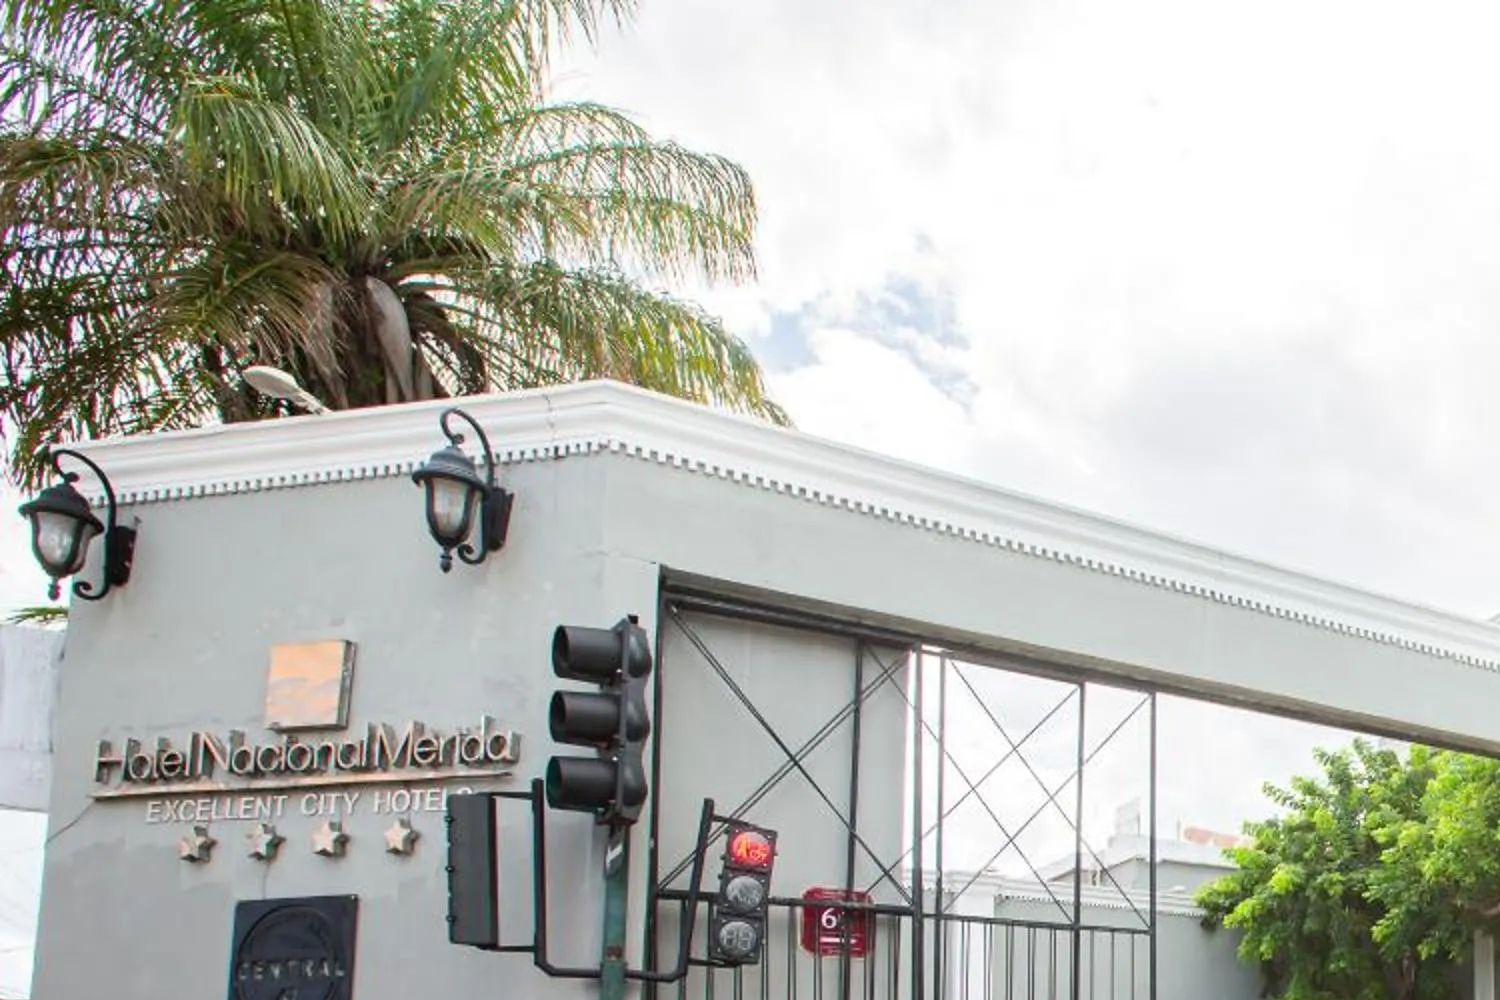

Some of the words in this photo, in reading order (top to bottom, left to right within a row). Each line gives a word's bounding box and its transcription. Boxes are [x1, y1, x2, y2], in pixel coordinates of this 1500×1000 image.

[146, 795, 288, 824] EXCELLENT
[301, 791, 359, 815] CITY
[373, 787, 472, 814] HOTEL
